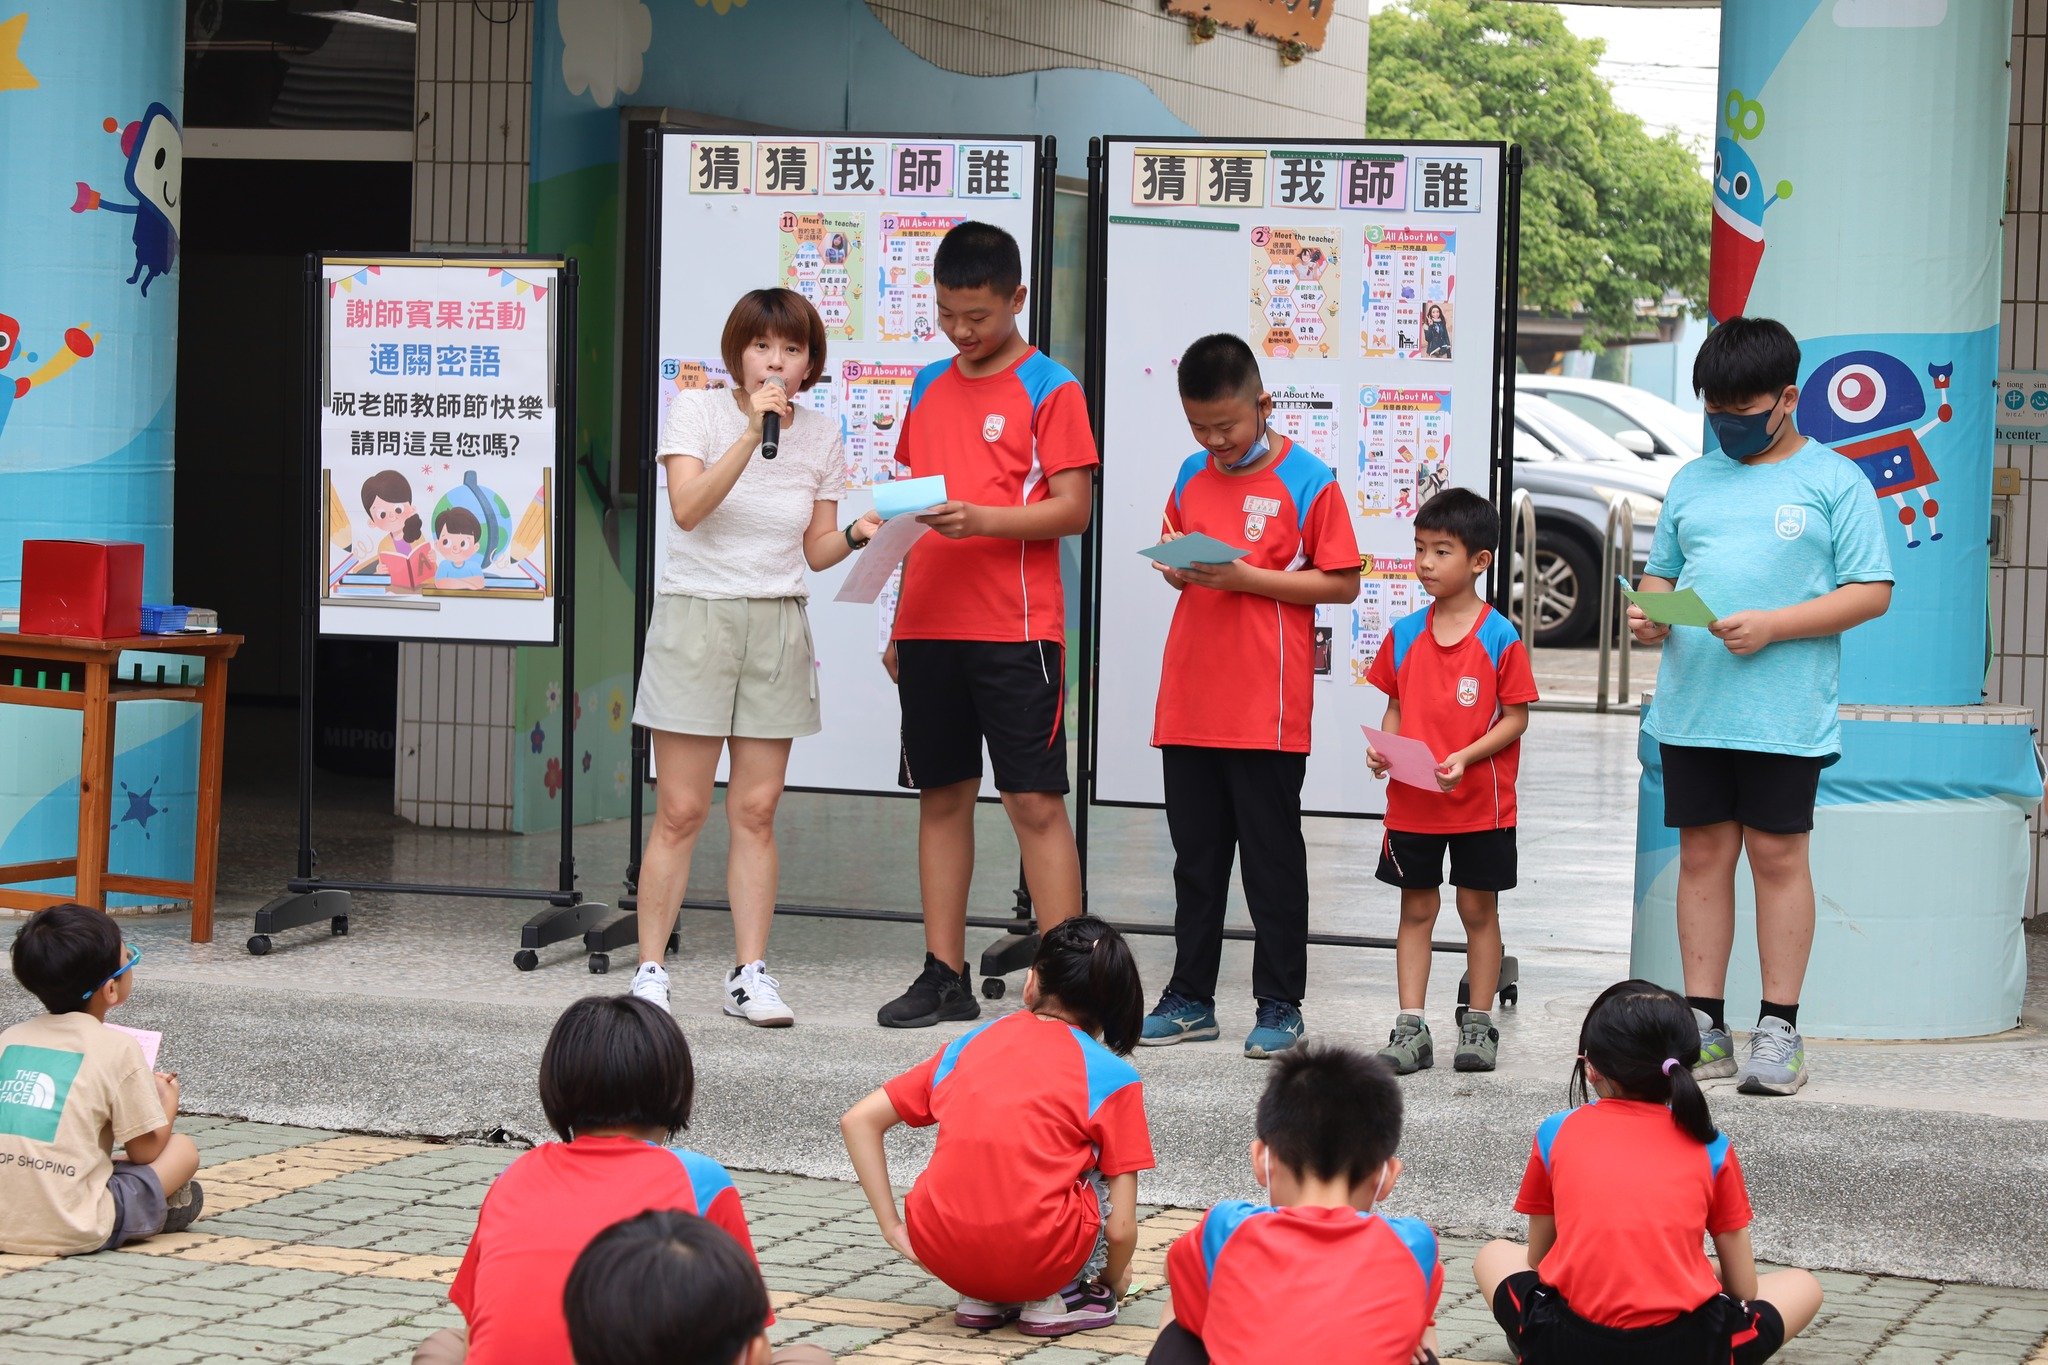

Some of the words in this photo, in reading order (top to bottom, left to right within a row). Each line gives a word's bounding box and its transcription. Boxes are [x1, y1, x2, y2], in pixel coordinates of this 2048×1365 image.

[783, 217, 793, 227] 11
[835, 220, 860, 228] teacher
[883, 219, 894, 229] 12
[900, 218, 910, 227] All
[912, 218, 936, 228] About
[938, 218, 950, 227] Me
[1256, 231, 1264, 242] 2
[1371, 229, 1379, 240] 3
[1385, 232, 1396, 242] All
[1398, 232, 1423, 242] About
[1426, 233, 1438, 242] Me
[345, 299, 526, 332] 謝師賓果活動
[369, 343, 500, 377] 通關密語
[664, 364, 675, 374] 13
[684, 364, 700, 372] Meet
[847, 366, 859, 376] 15
[862, 368, 872, 376] All
[874, 367, 898, 376] About
[901, 368, 912, 376] Me
[2007, 381, 2024, 389] tiong
[1311, 391, 1325, 399] Me
[1363, 391, 1374, 403] 6
[1381, 392, 1391, 401] All
[1394, 391, 1418, 401] About
[1421, 393, 1434, 401] Me
[331, 392, 543, 420] 祝老師教師節快樂
[2006, 429, 2041, 440] center
[351, 431, 519, 458] 請問這是您嗎?
[1374, 560, 1384, 570] All
[1387, 561, 1413, 571] About
[324, 727, 394, 750] MIPRO
[15, 1069, 39, 1081] THE
[0, 1092, 30, 1105] FACE
[17, 1155, 76, 1177] SHOPING
